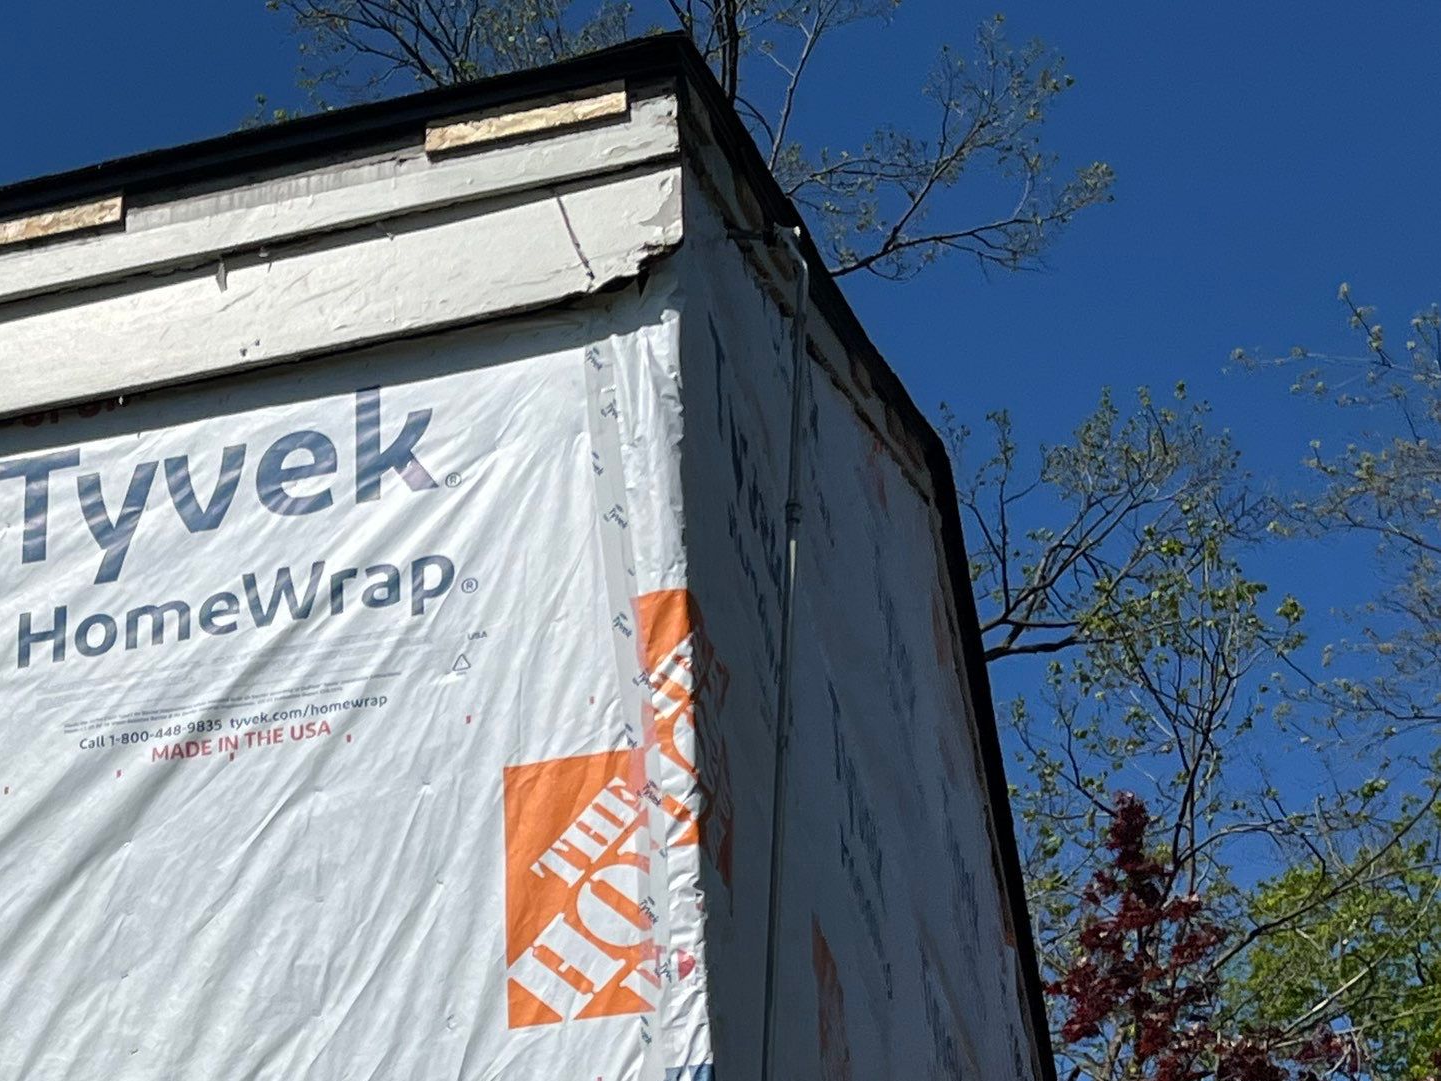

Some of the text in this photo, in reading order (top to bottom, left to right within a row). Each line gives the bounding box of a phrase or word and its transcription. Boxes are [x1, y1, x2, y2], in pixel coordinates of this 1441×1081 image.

[16, 554, 456, 668] HomeWrap
[79, 694, 388, 750] Call 1-800-448-9835 tyvek.com/homewrap
[151, 723, 331, 763] MADE IN THE USA
